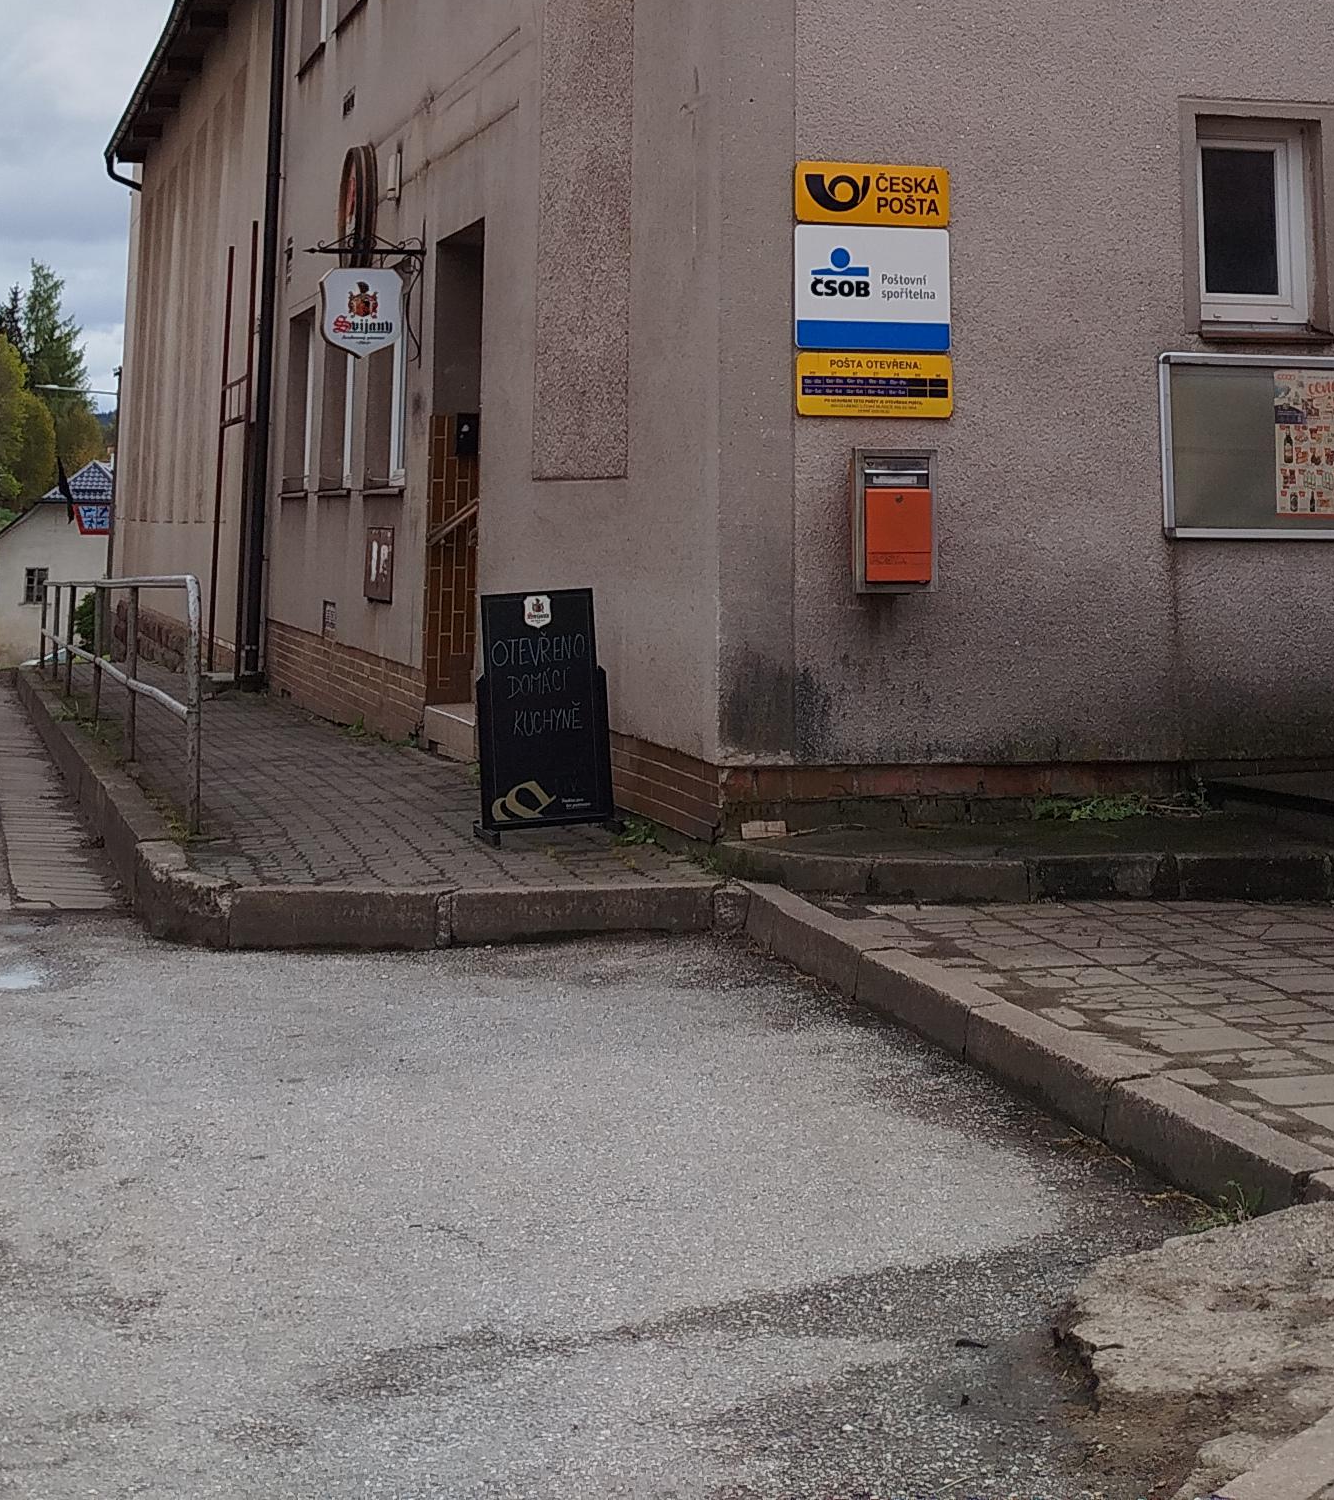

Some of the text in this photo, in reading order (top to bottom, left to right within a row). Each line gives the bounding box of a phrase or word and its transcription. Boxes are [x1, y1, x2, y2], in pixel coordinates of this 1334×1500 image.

[875, 173, 940, 195] ČESKÁ
[876, 195, 940, 216] POŠTA
[810, 277, 871, 298] ČSOB
[881, 274, 927, 287] Poštovní
[881, 288, 936, 301] spořitelna
[333, 314, 393, 334] Svijany
[829, 357, 864, 369] POŠTA
[491, 631, 586, 667] OTEVŘENO
[513, 700, 584, 737] KUCHYNĚ
